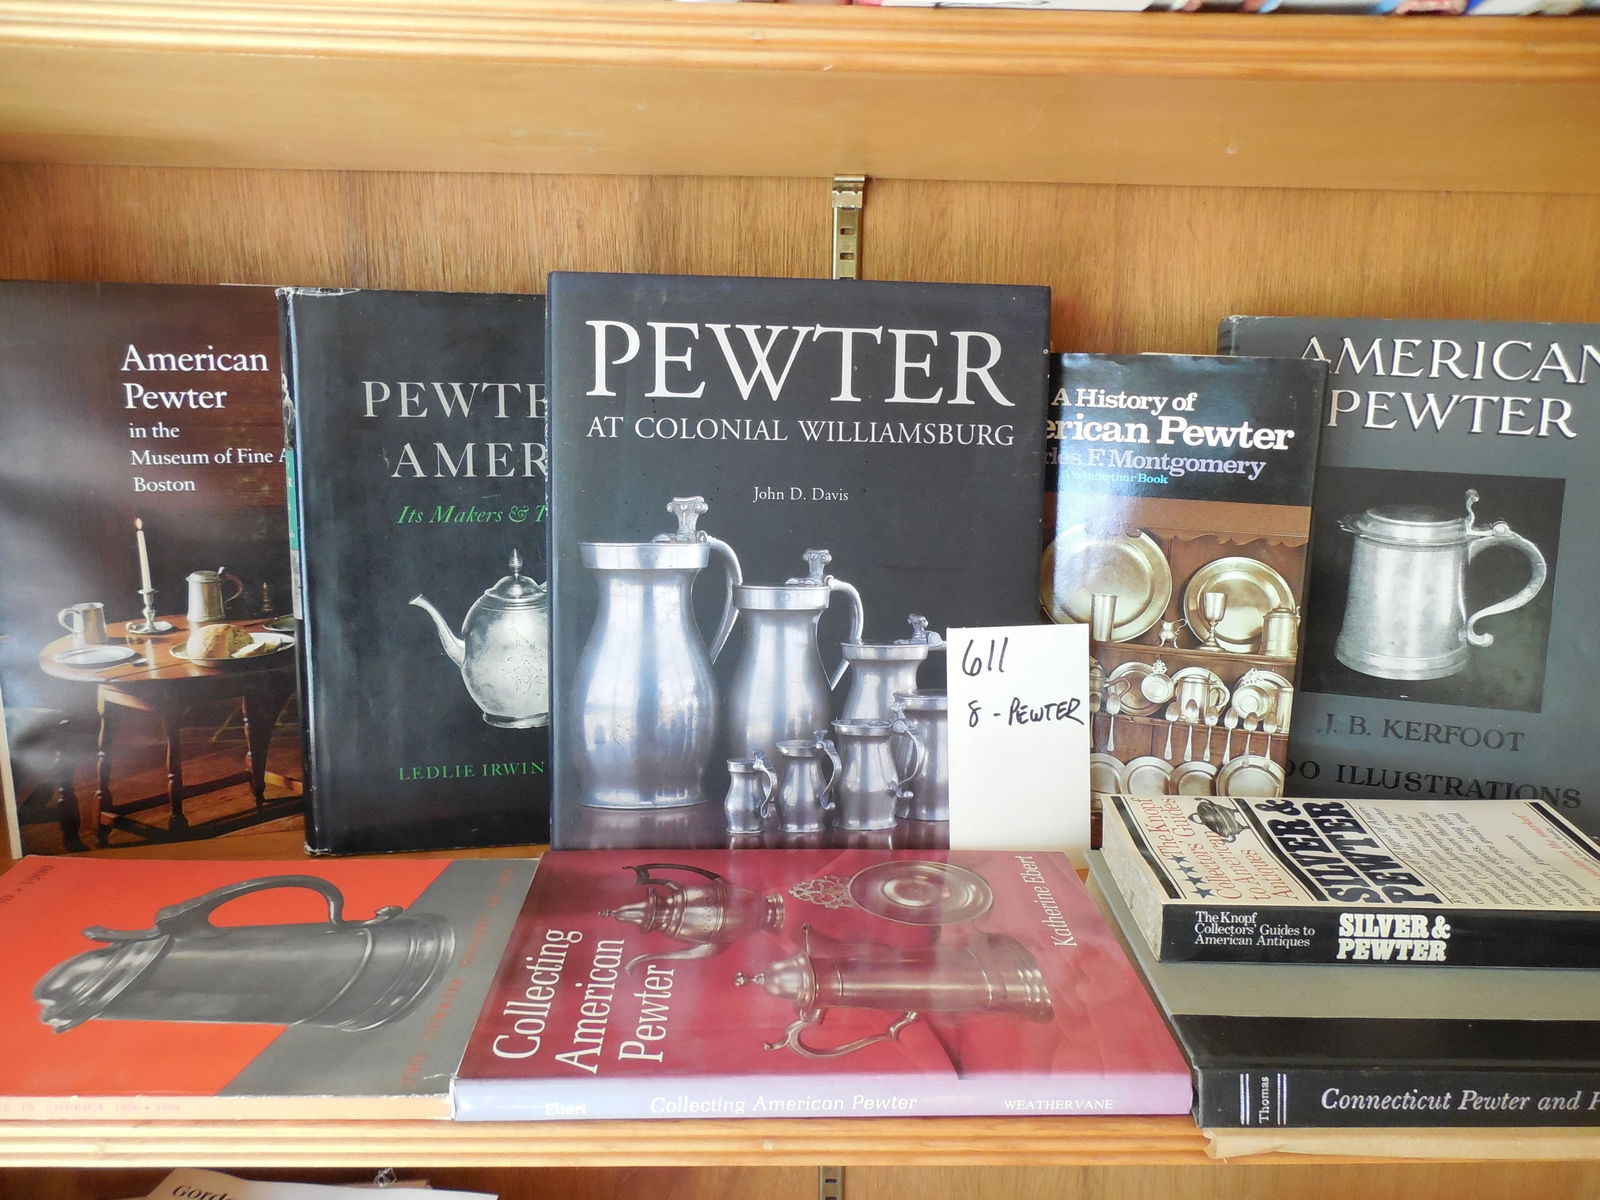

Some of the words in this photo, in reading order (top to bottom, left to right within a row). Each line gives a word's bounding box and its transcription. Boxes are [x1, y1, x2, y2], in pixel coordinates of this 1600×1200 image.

[120, 344, 269, 372] American
[584, 319, 1016, 407] PEWTER
[123, 383, 228, 409] Pewter
[1051, 391, 1071, 406] A
[1075, 388, 1169, 416] History
[1172, 392, 1198, 411] of
[1327, 389, 1578, 439] PEWTER
[129, 423, 147, 438] in
[152, 422, 180, 438] the
[586, 416, 624, 439] AT
[634, 417, 788, 441] COLONIAL
[798, 420, 1015, 447] WILLIAMSBURG
[1156, 415, 1295, 450] Pewter
[131, 450, 209, 465] Museum
[214, 448, 233, 464] of
[237, 448, 274, 464] Fine
[391, 442, 546, 478] AMER
[1110, 449, 1267, 481] Montgomery
[133, 477, 196, 492] Boston
[1138, 473, 1168, 484] Book
[752, 486, 786, 503] John
[790, 487, 807, 502] D.
[811, 487, 849, 503] Davis
[396, 505, 423, 524] Its
[428, 505, 503, 523] Makers
[508, 505, 530, 522] &
[962, 637, 1008, 676] 611
[968, 700, 981, 727] 8
[1008, 697, 1084, 726] PEWTER
[1349, 715, 1371, 736] B.
[1383, 718, 1526, 752] KERFOOT
[399, 764, 475, 781] LEDLIE
[482, 761, 545, 777] IRWIN
[1335, 763, 1582, 809] ILLUSTRATIONS
[1131, 797, 1168, 832] Knopf
[1160, 797, 1196, 838] Guides
[1254, 799, 1301, 816] &
[1157, 834, 1184, 857] The
[1206, 830, 1251, 884] American
[1302, 801, 1442, 904] PEWTER
[1015, 855, 1046, 884] Ebert
[1267, 818, 1384, 903] SILVER
[1239, 849, 1300, 901] Antiques
[1250, 887, 1272, 900] to
[1033, 886, 1078, 947] Katherine
[1194, 923, 1256, 936] Collectors'
[1259, 924, 1300, 936] Guides
[1303, 926, 1315, 936] to
[1195, 911, 1219, 923] The
[1220, 912, 1257, 925] Knopf
[1339, 912, 1429, 939] SILVER
[1431, 915, 1451, 939] &
[1194, 935, 1253, 945] American
[1255, 935, 1310, 949] Antiques
[1336, 938, 1447, 961] PEWTER
[492, 928, 583, 1059] Collecting
[554, 939, 625, 1074] American
[618, 964, 674, 1063] Pewter
[545, 1101, 587, 1116] Ebert
[650, 1097, 745, 1114] Collecting
[752, 1096, 844, 1112] American
[851, 1095, 917, 1110] Pewter
[1003, 1099, 1114, 1110] WEATHERVANE
[1258, 1076, 1270, 1123] Thomas
[1320, 1087, 1452, 1110] Connecticut
[1457, 1089, 1530, 1111] Pewter
[1537, 1090, 1583, 1111] and
